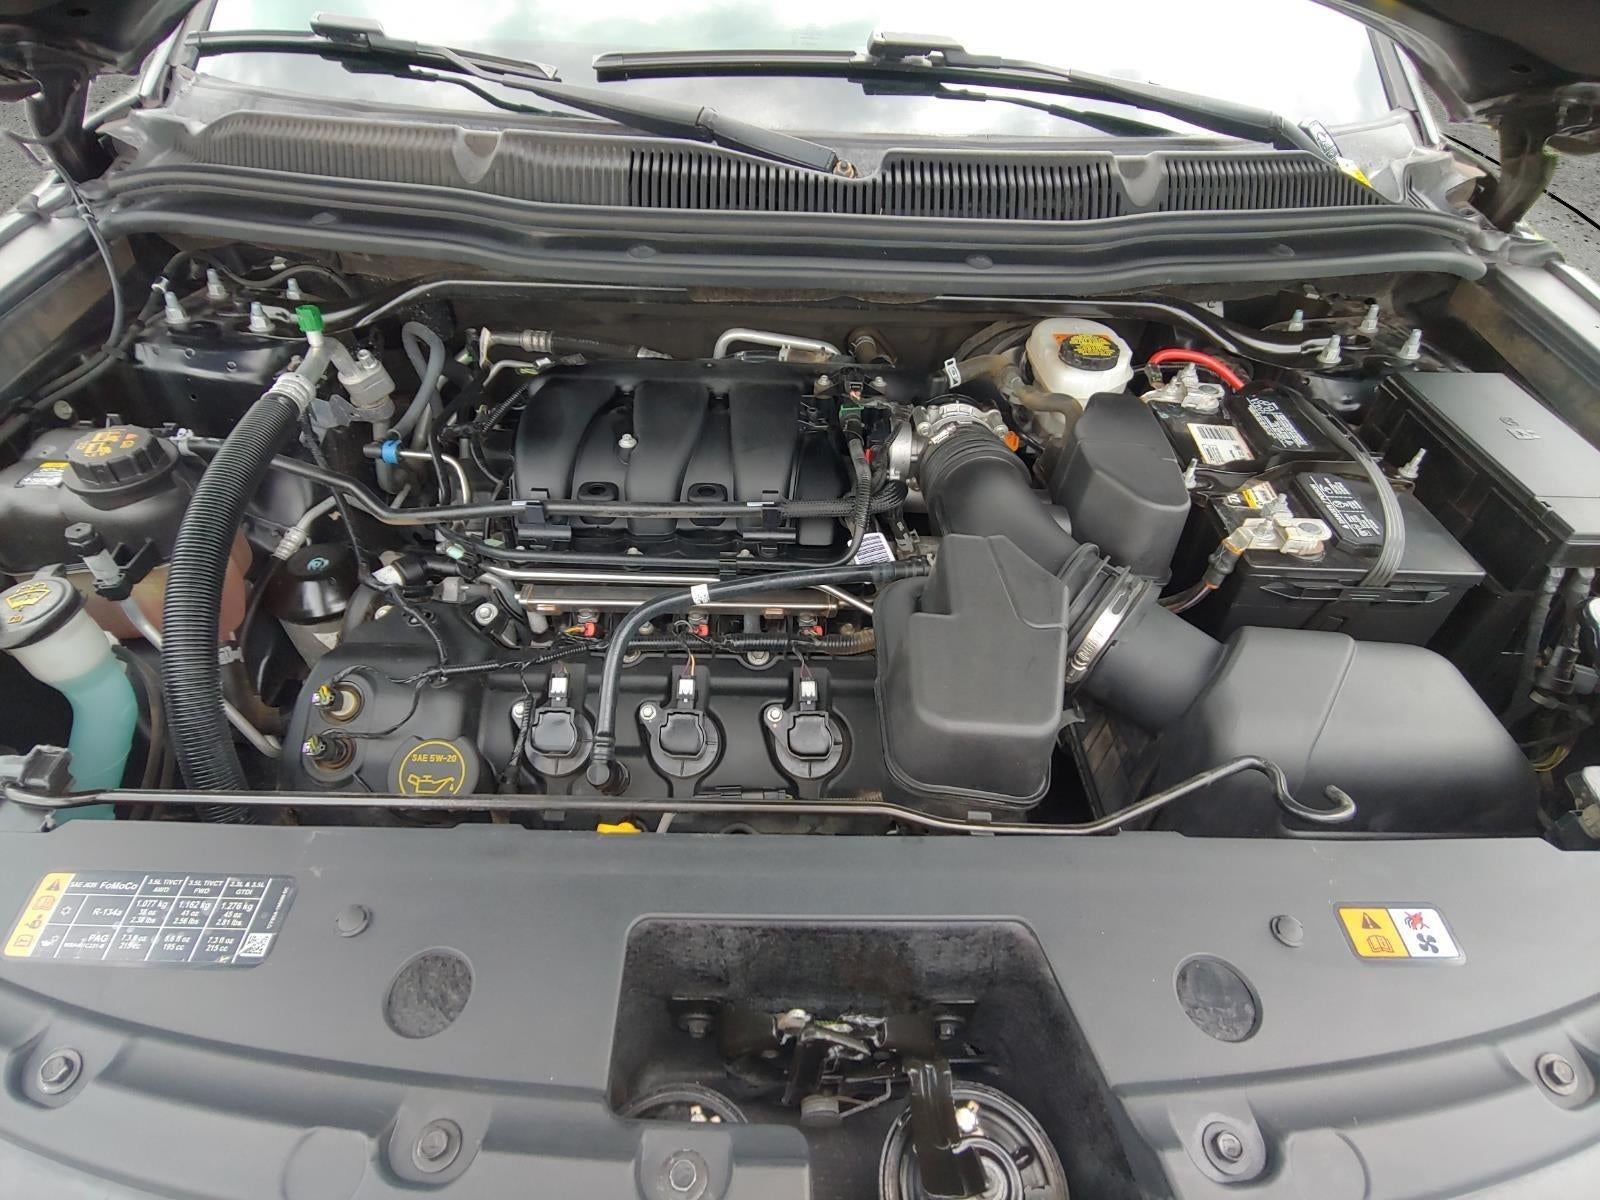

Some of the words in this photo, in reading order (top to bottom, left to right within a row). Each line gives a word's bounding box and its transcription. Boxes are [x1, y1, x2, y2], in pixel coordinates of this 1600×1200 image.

[412, 753, 428, 762] SAE
[430, 754, 457, 763] 5W-20
[99, 881, 138, 890] FoMoCo
[136, 900, 157, 908] 1.077
[157, 901, 169, 910] kg
[178, 901, 201, 909] 1.162
[200, 901, 212, 912] kg
[220, 902, 243, 910] 1.276
[242, 902, 255, 913] kg
[92, 908, 123, 916] R-134a
[87, 934, 111, 943] PAG
[205, 944, 220, 952] 215
